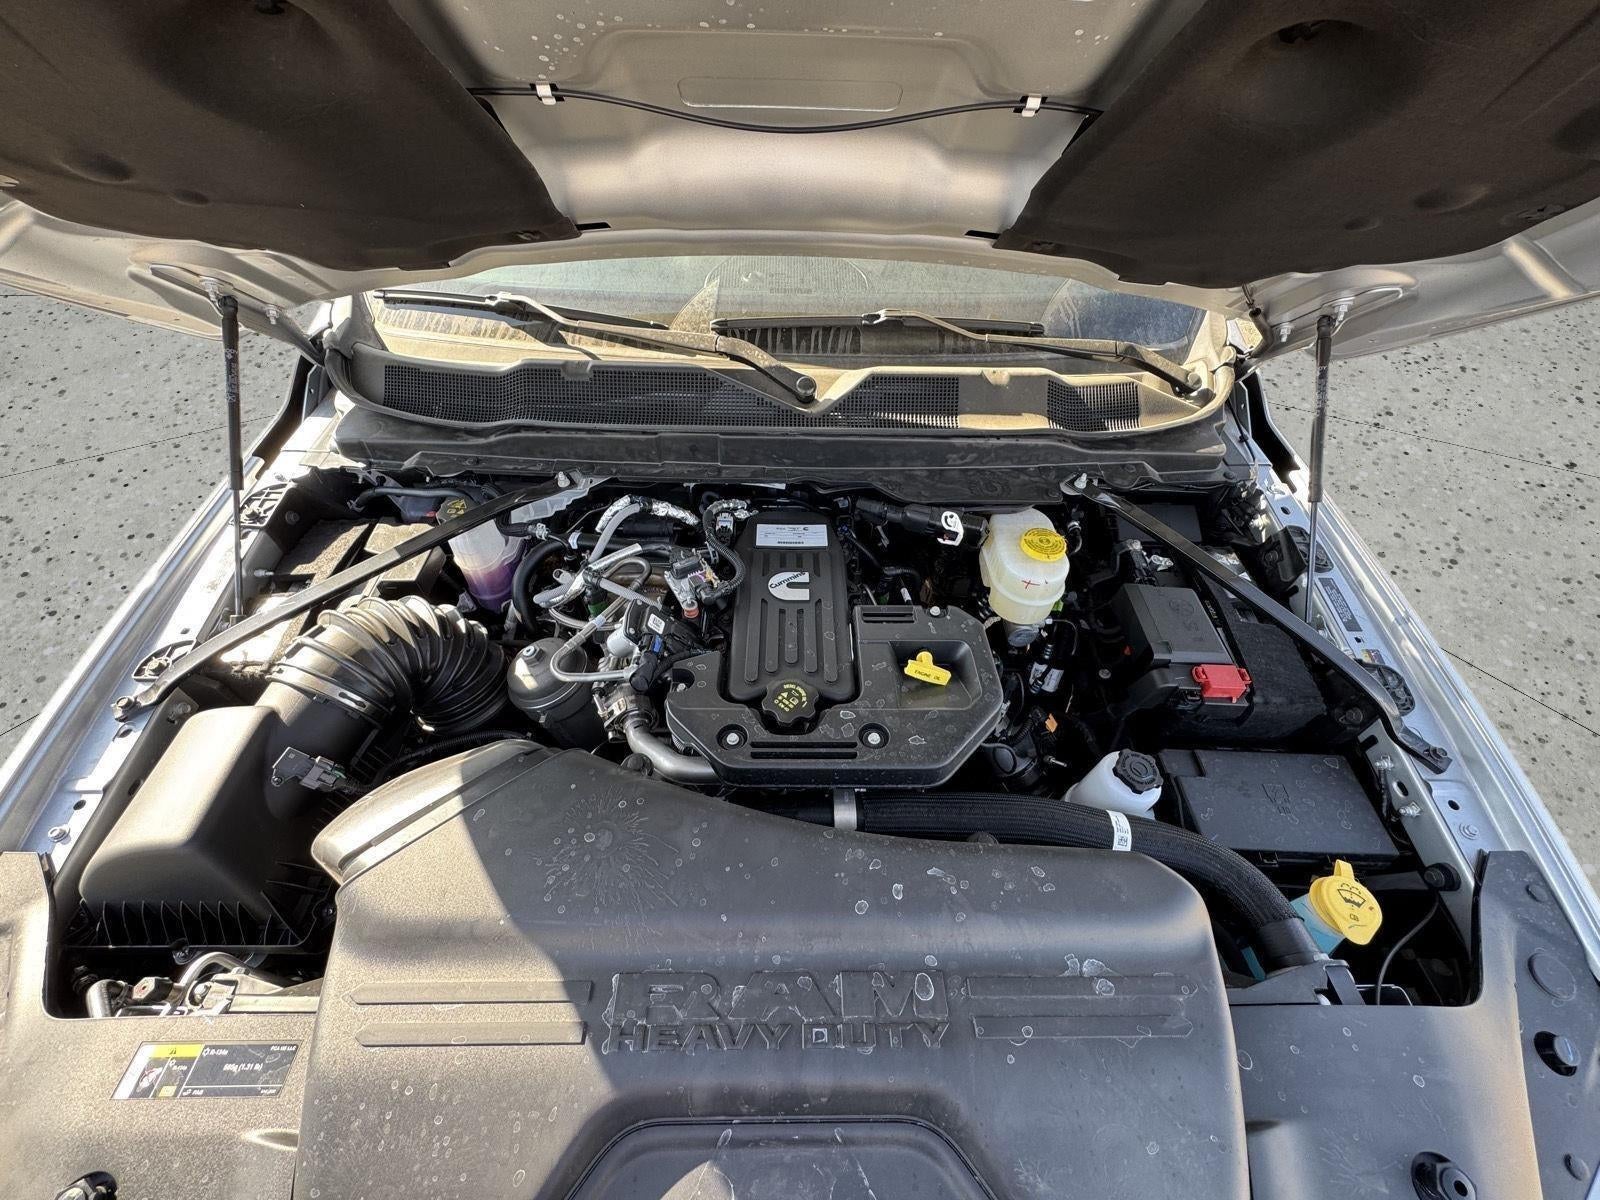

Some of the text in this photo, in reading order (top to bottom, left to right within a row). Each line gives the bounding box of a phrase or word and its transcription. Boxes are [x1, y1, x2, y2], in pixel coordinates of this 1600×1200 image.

[769, 571, 806, 589] Cummins
[602, 969, 950, 1021] RAM
[605, 1022, 951, 1052] HEAVY DUTY
